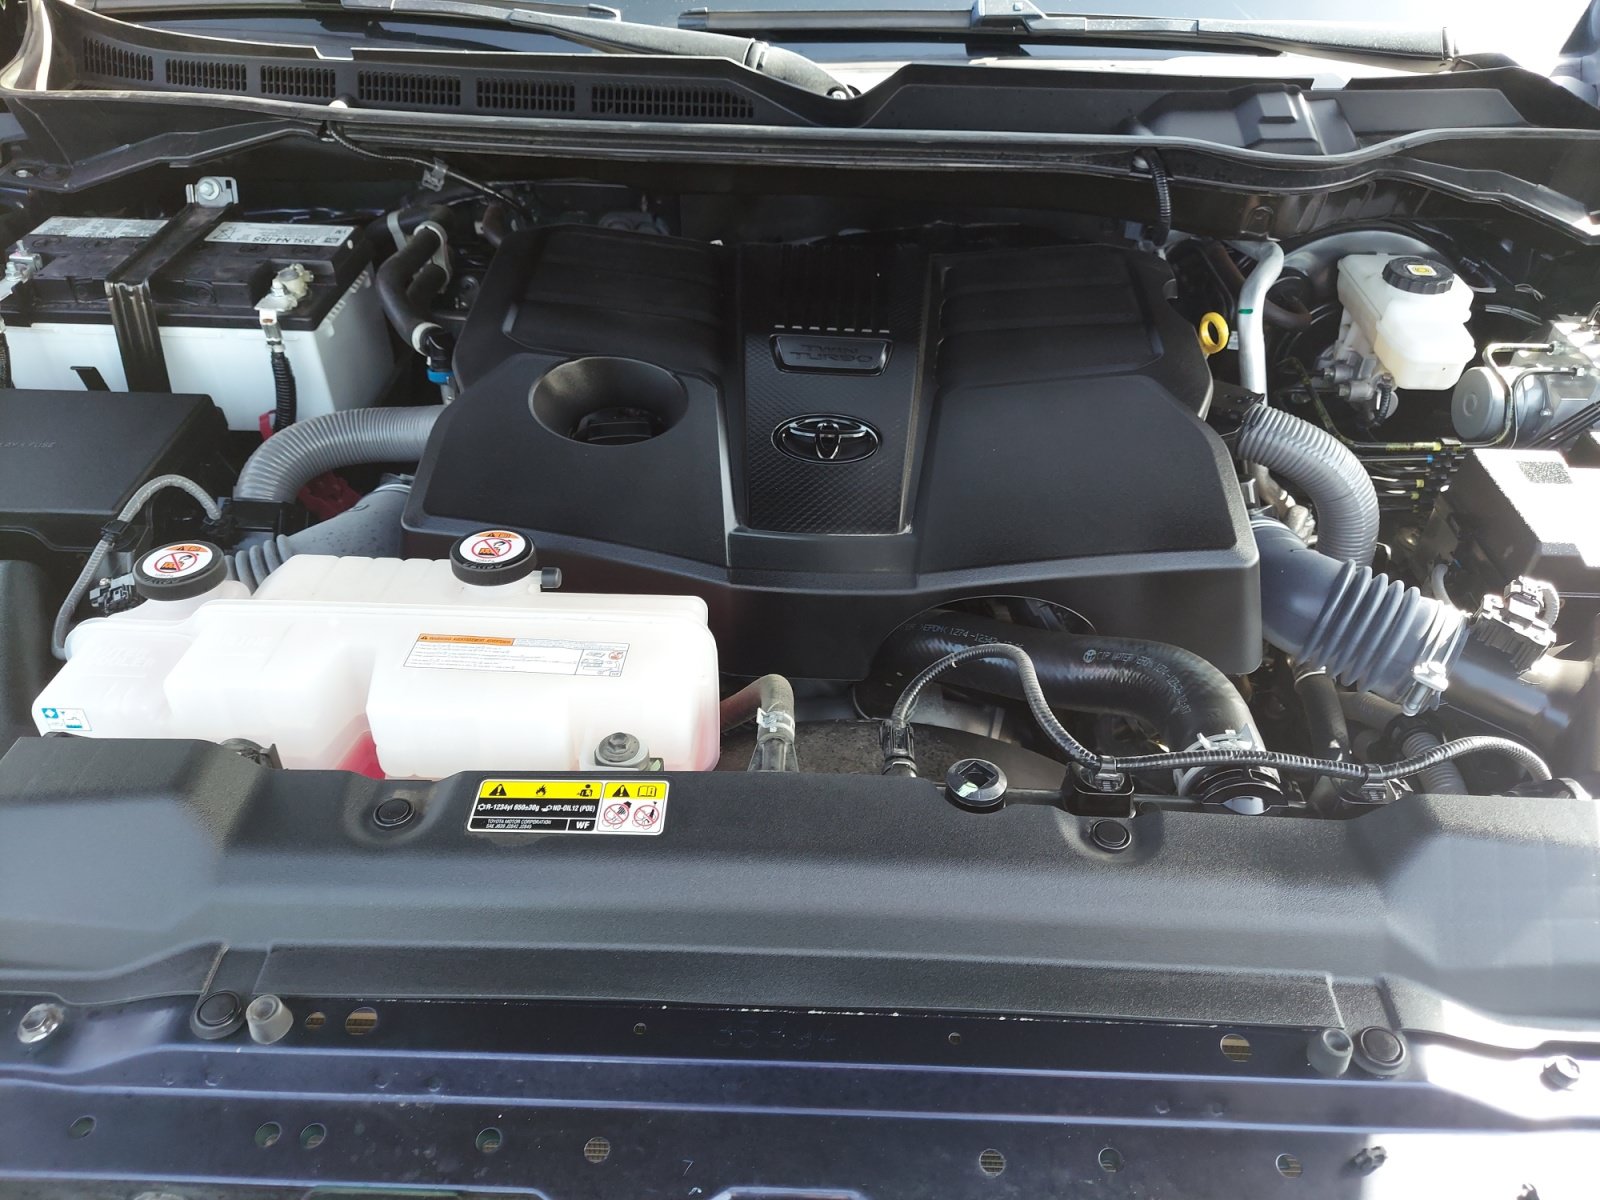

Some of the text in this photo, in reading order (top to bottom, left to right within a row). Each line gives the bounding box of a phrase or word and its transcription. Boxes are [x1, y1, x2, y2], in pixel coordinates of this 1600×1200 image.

[485, 803, 512, 812] R-1234yf
[579, 805, 596, 813] (POE)
[576, 821, 590, 830] WF
